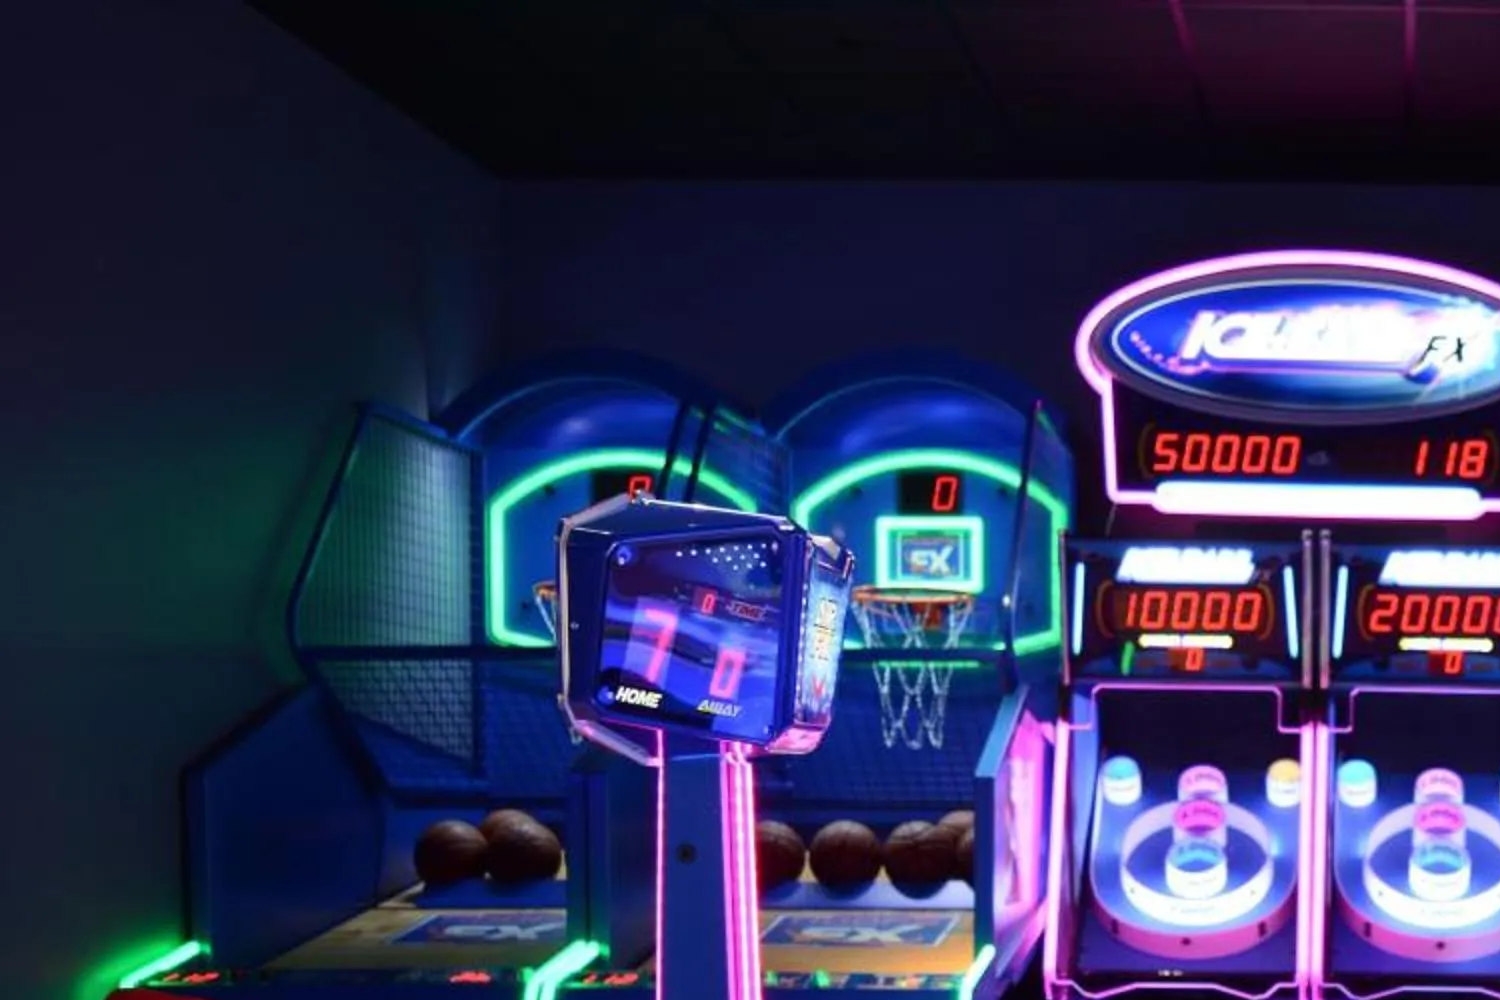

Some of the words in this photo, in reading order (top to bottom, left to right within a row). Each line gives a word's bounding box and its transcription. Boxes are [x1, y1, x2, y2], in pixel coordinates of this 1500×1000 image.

[1418, 335, 1468, 364] FX
[1153, 433, 1300, 475] 50000
[1414, 439, 1489, 478] 118
[932, 476, 958, 512] 0
[701, 592, 717, 614] 0
[1126, 591, 1263, 631] 10000
[643, 608, 678, 684] 7
[709, 650, 746, 698] 0
[615, 687, 662, 708] HOME
[697, 700, 743, 718] AWAY
